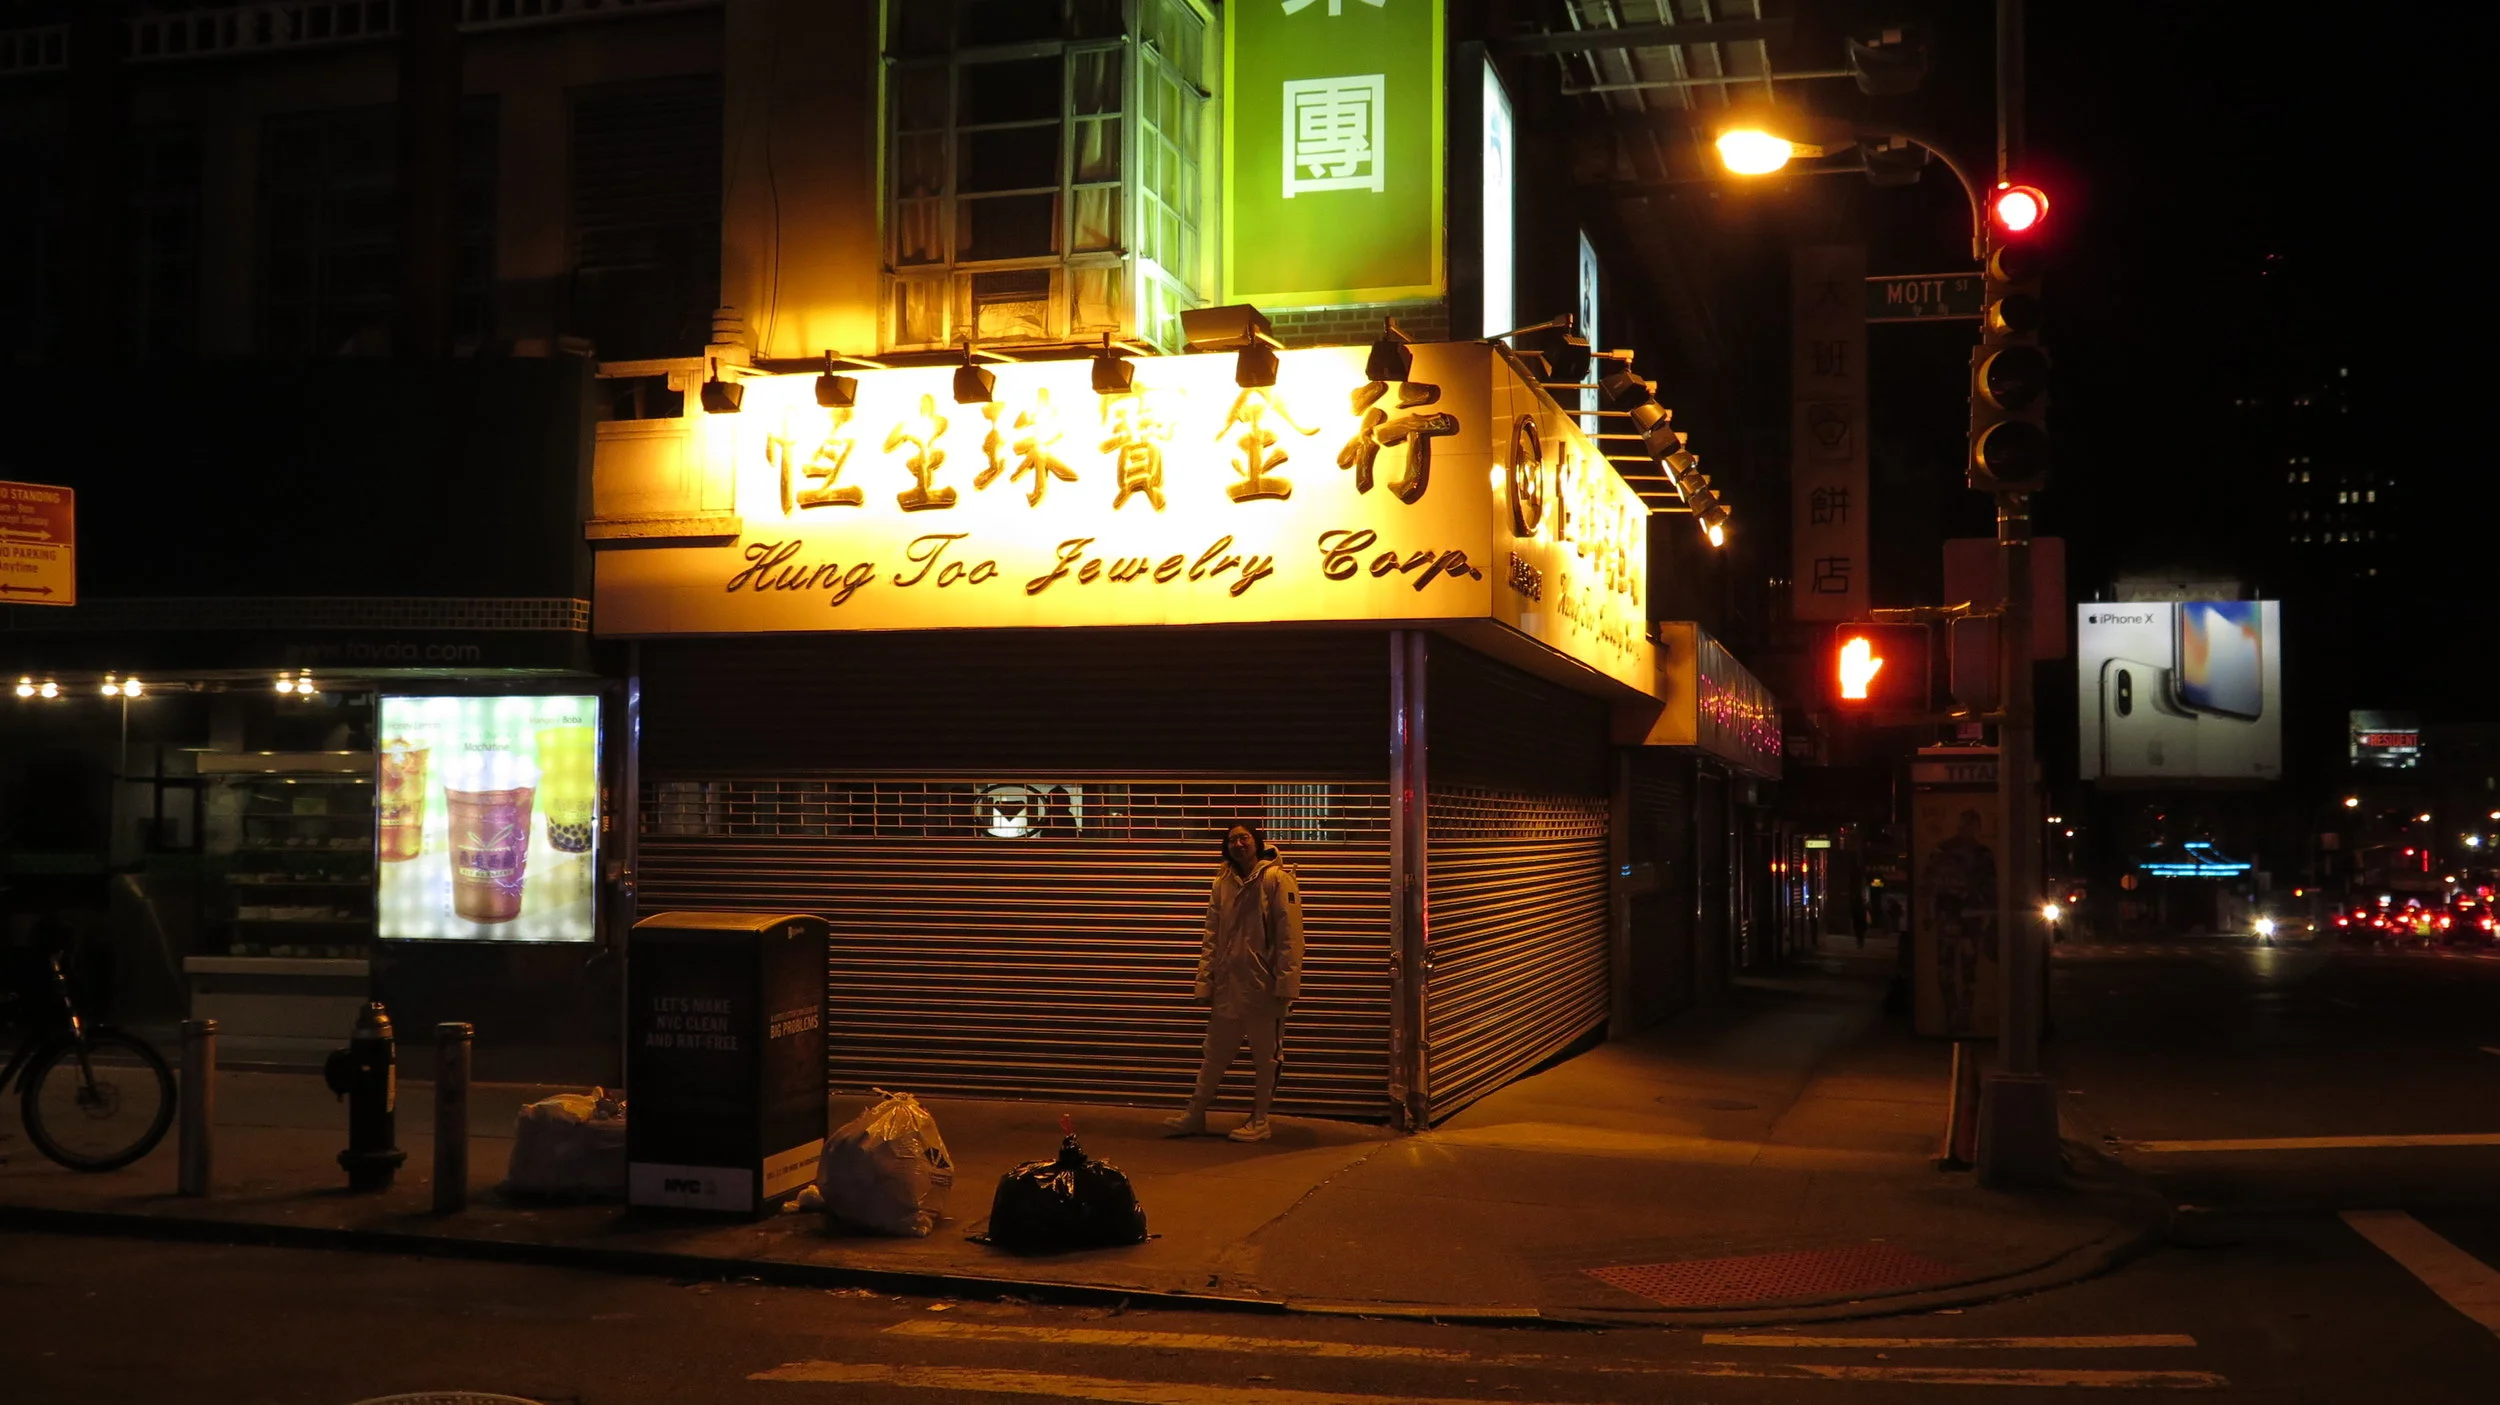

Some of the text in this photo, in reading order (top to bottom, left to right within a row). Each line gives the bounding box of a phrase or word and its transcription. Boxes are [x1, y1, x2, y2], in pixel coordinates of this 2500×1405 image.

[1887, 280, 1968, 304] MOTT ST
[11, 489, 60, 504] STANDING
[12, 547, 56, 561] PARKING
[727, 539, 875, 606] Hung
[893, 532, 998, 588] Too
[1026, 534, 1274, 597] Jewelry
[1318, 529, 1483, 591] Corp.
[2099, 612, 2154, 625] iPhone X
[562, 716, 582, 724] Boba
[1945, 764, 1998, 781] TITA
[653, 996, 732, 1014] LET'S MAKE
[656, 1014, 728, 1033] NYC CLEAN
[645, 1031, 673, 1048] AND
[664, 1178, 701, 1194] NYC
